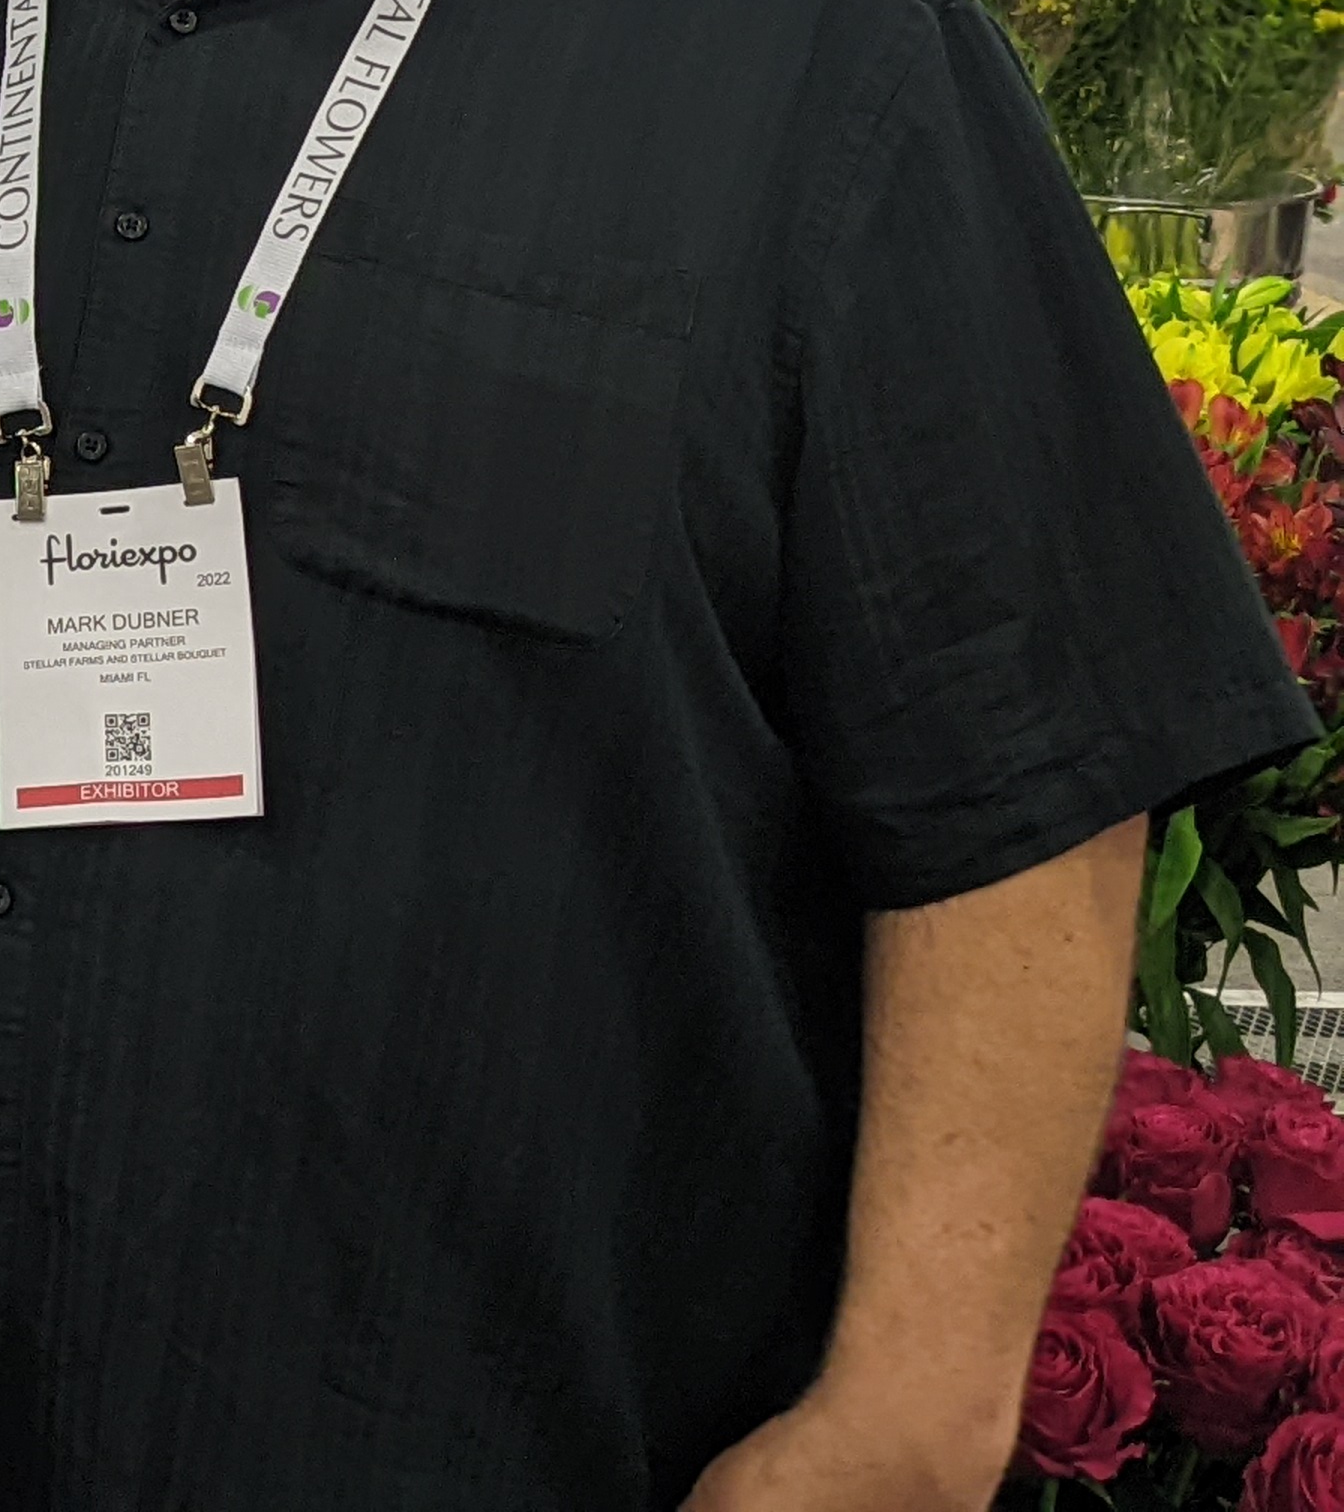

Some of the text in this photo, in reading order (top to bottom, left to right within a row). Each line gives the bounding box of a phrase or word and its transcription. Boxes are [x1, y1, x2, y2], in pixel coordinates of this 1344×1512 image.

[273, 55, 391, 244] FLOWERS
[40, 533, 197, 586] floriexpo
[196, 571, 231, 587] 2022
[47, 608, 200, 635] MARK DUBNER
[62, 635, 186, 652] MANAGING PARTNER
[23, 648, 227, 670] STELLAR FARMS AND STELLAR BOUQUET
[99, 671, 152, 684] MIAMI FL
[104, 763, 153, 777] 201249
[80, 781, 179, 801] EXHIBITOR
